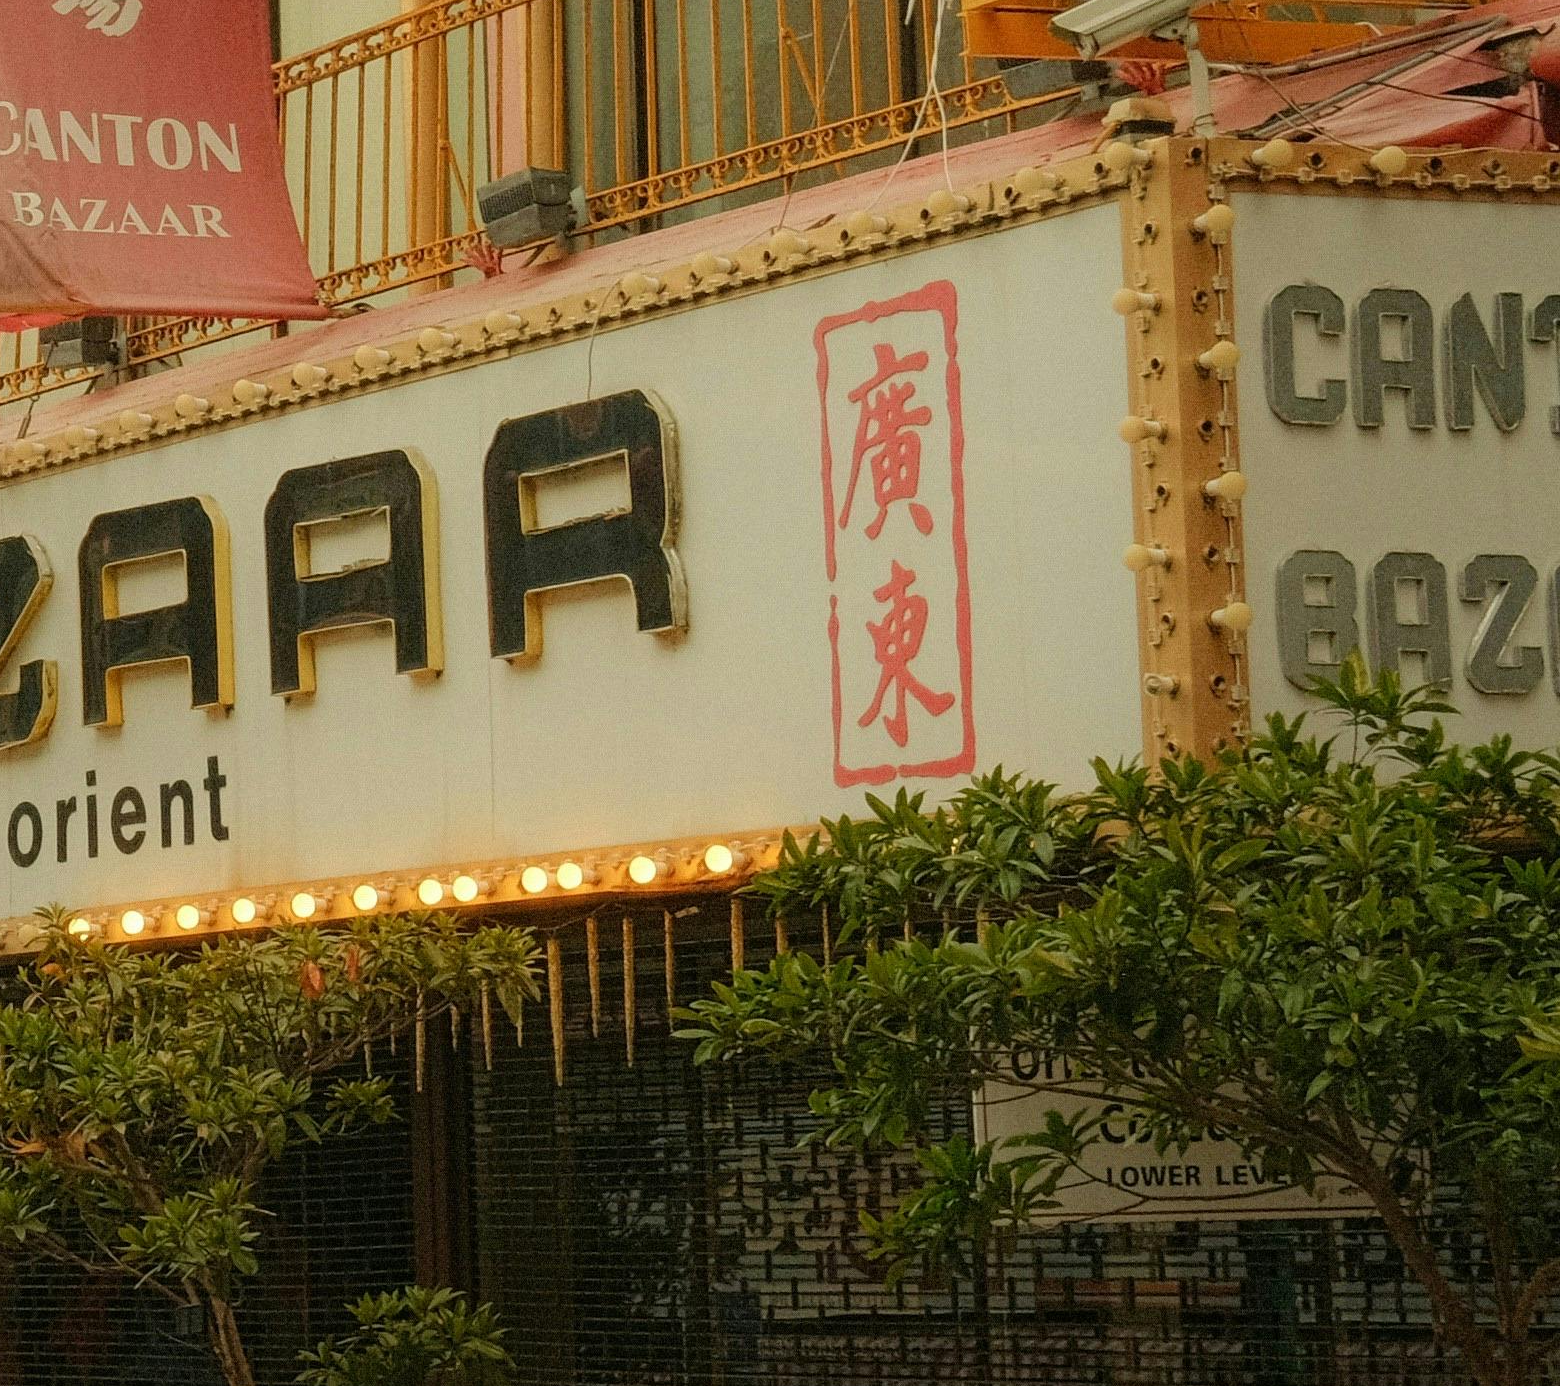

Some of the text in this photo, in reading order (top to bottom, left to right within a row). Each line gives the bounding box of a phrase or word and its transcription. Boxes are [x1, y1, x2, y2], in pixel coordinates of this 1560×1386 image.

[11, 189, 231, 240] BAZAAR
[837, 341, 956, 749] 廣東
[1273, 548, 1560, 697] BAZ
[8, 755, 231, 869] orient
[1215, 1164, 1296, 1187] LEVE
